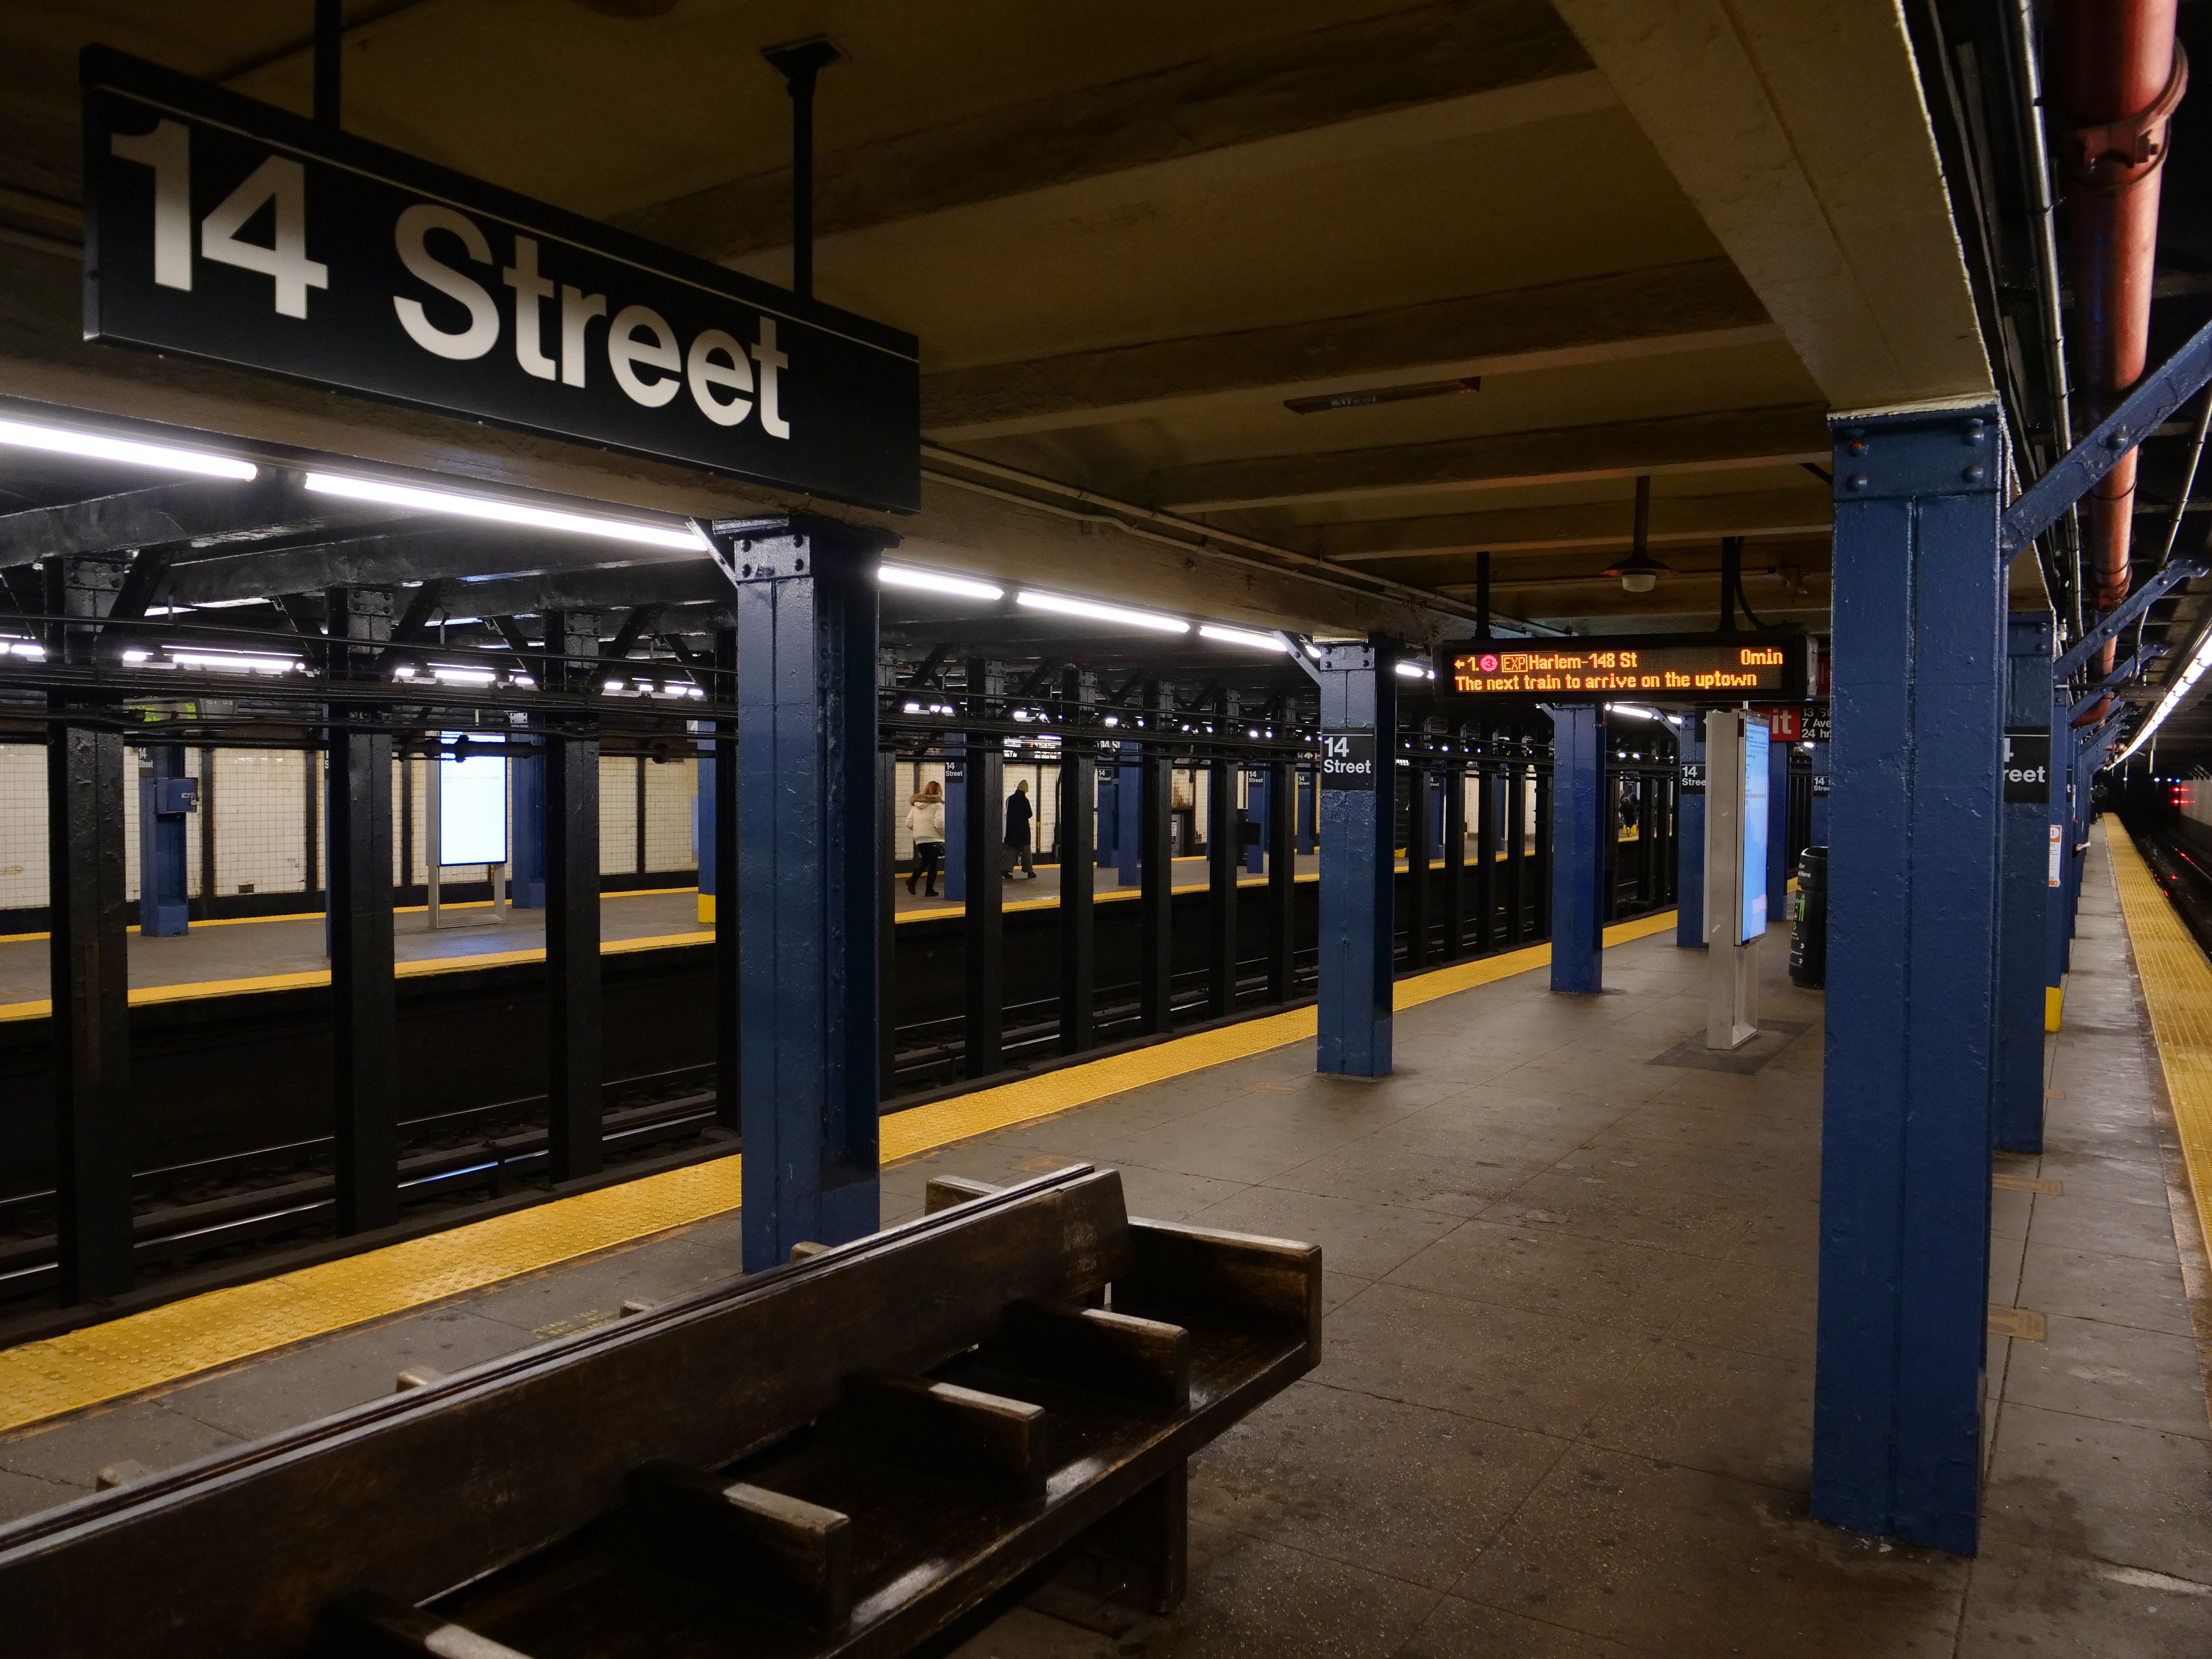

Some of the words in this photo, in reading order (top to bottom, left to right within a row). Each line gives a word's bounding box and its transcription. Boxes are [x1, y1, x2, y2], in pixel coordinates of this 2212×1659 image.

[111, 118, 329, 320] 14
[393, 204, 790, 440] Street
[1503, 657, 1526, 670] EXP
[1620, 652, 1638, 667] St
[1455, 676, 1483, 691] The
[1486, 675, 1520, 690] next
[1524, 675, 1561, 689] train
[1565, 674, 1581, 689] to
[1585, 673, 1637, 689] arrive
[1641, 676, 1660, 688] on
[1665, 672, 1691, 687] the
[1695, 670, 1757, 689] uptown
[1801, 707, 1814, 717] 13
[1772, 708, 1792, 734] it
[1801, 718, 1809, 727] 7
[1813, 719, 1831, 728] Ave
[1801, 729, 1816, 738] 24
[1820, 729, 1832, 738] hr
[138, 747, 147, 759] 14
[1324, 737, 1349, 757] 14
[2003, 738, 2014, 762] 4
[138, 760, 153, 768] Street
[1324, 759, 1371, 773] Street
[1682, 766, 1697, 778] 14
[2003, 766, 2046, 783] reet
[1682, 778, 1707, 786] Stree
[1813, 776, 1825, 785] 14
